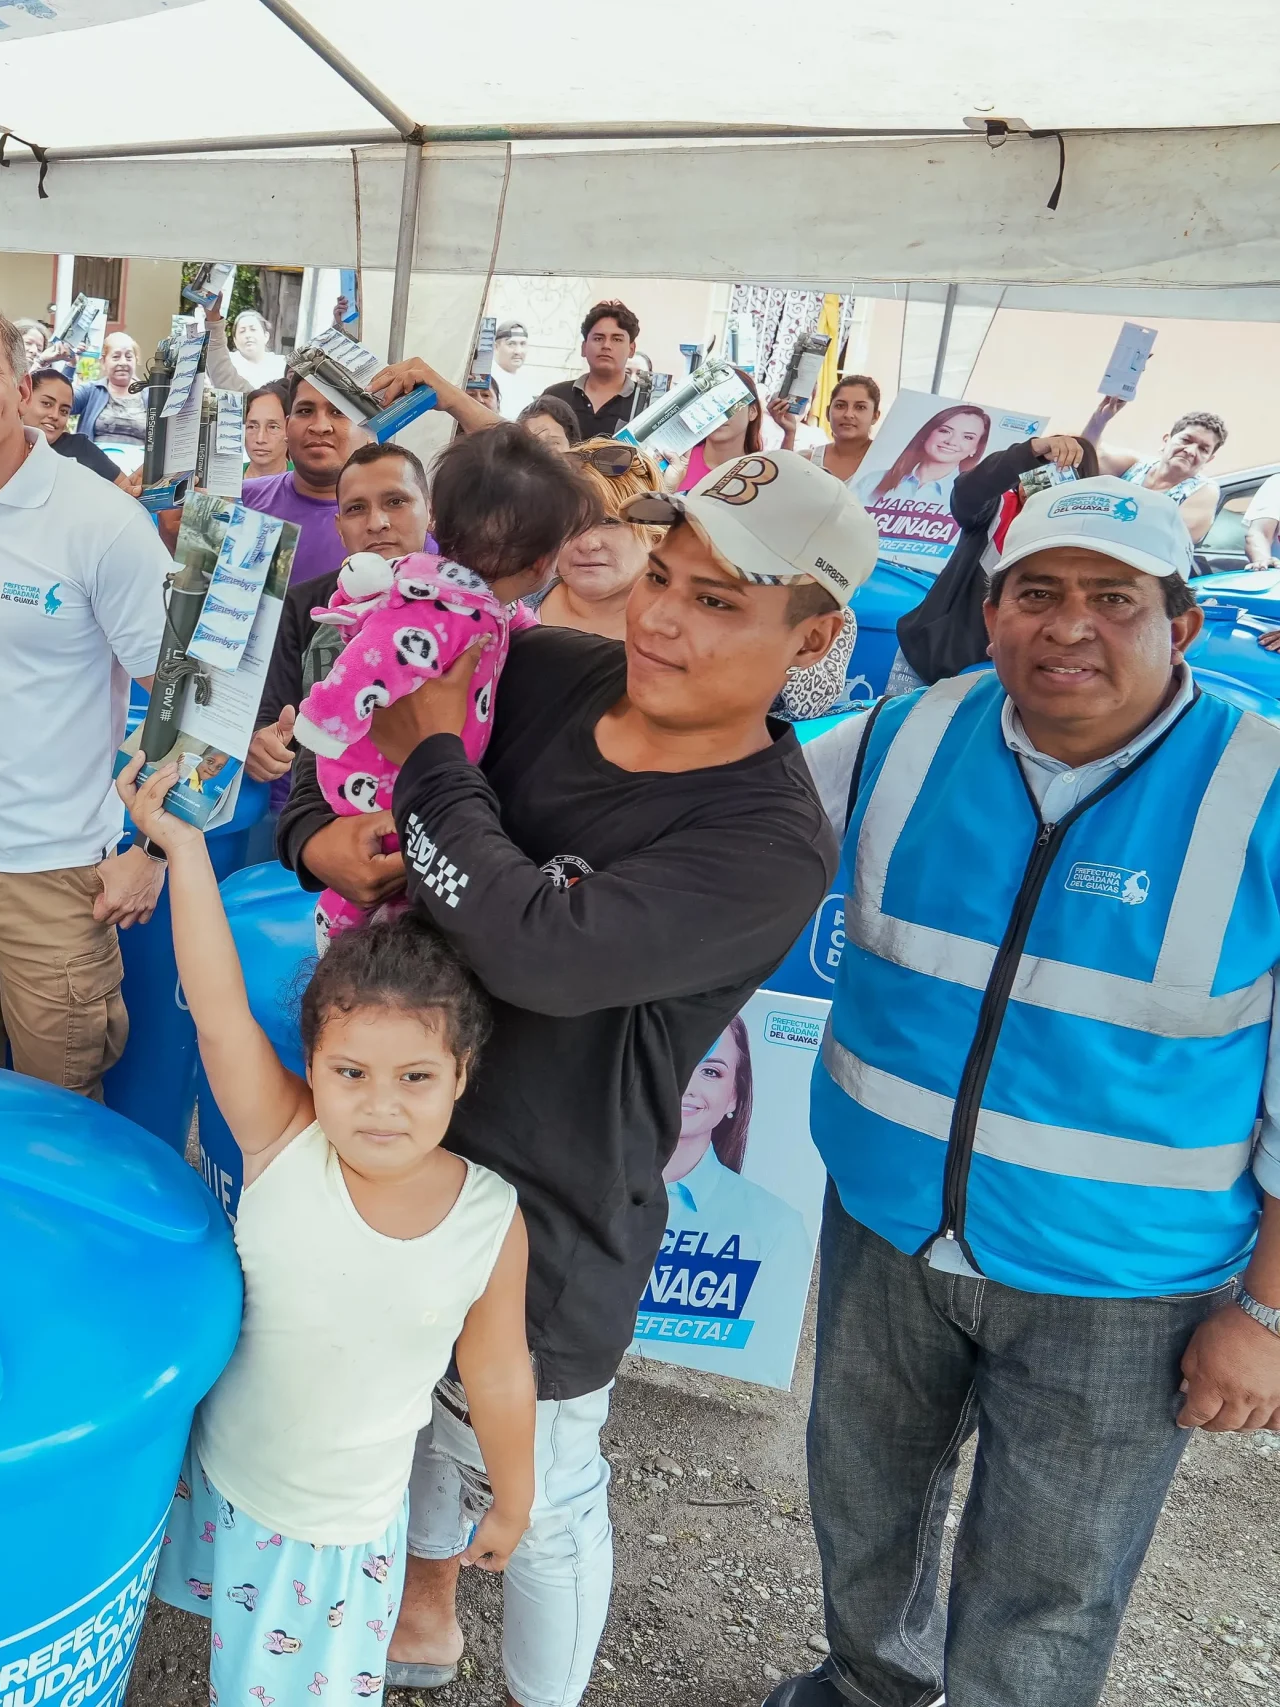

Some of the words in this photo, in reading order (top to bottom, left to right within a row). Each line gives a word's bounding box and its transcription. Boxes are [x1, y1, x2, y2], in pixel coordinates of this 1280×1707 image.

[1053, 506, 1069, 514] DEL
[815, 556, 850, 591] BURBERRY
[3, 582, 41, 594] PREFECTURA
[219, 573, 253, 592] Aquatabs
[0, 593, 12, 601] DEL
[13, 596, 39, 606] GUAYAS
[2, 588, 40, 599] CIUDADANA
[210, 602, 244, 621] Aquatabs
[200, 630, 234, 650] Aquatabs
[1073, 873, 1120, 887] CIUDADANA
[1074, 867, 1122, 880] PREFECTURA
[1070, 880, 1084, 888] DEL
[1085, 882, 1119, 893] GUAYAS
[771, 1023, 819, 1038] CIUDADANA
[772, 1017, 820, 1031] PREFECTURA
[770, 1030, 785, 1040] DEL
[787, 1034, 818, 1046] GUAYAS
[660, 1228, 740, 1259] CELA
[640, 1265, 737, 1311] ÑAGA
[634, 1315, 734, 1341] EFECTA!
